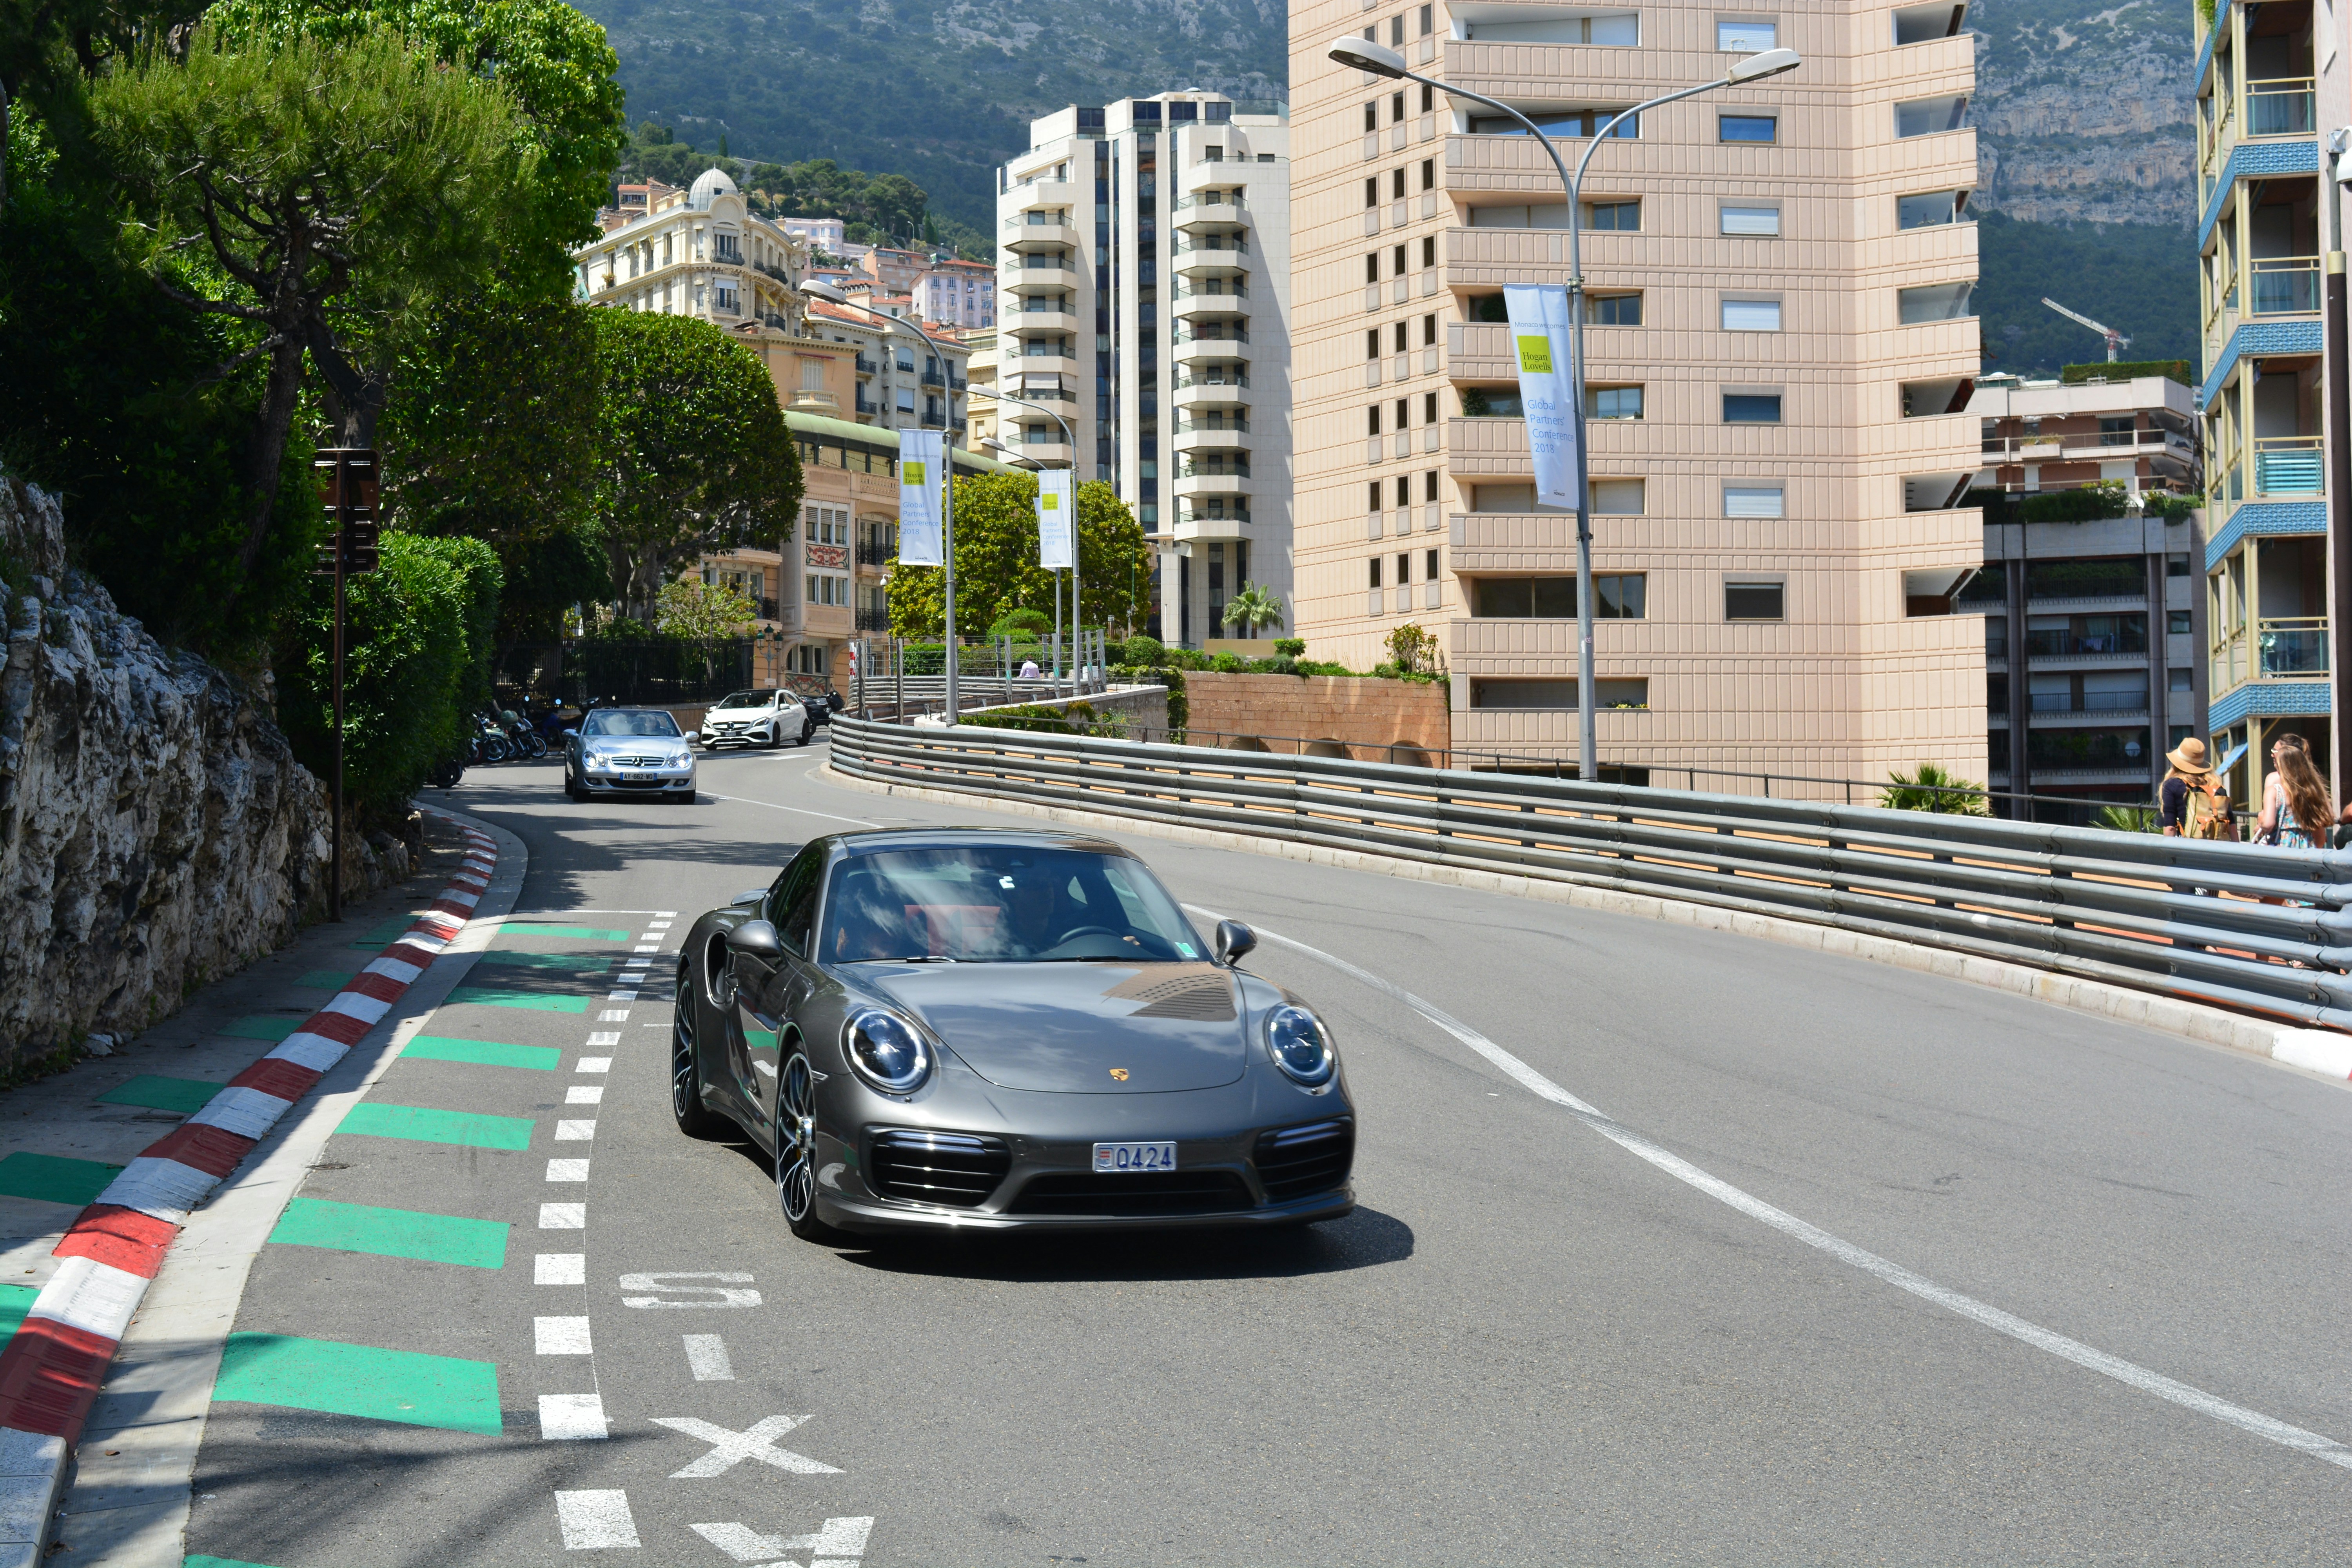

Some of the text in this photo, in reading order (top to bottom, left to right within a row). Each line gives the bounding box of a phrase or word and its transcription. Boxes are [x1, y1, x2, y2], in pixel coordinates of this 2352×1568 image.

[1523, 352, 1548, 362] Hogan
[1524, 362, 1551, 370] Lovells
[1528, 399, 1555, 410] Global
[1532, 428, 1574, 442] Conference
[1534, 443, 1555, 454] 2018
